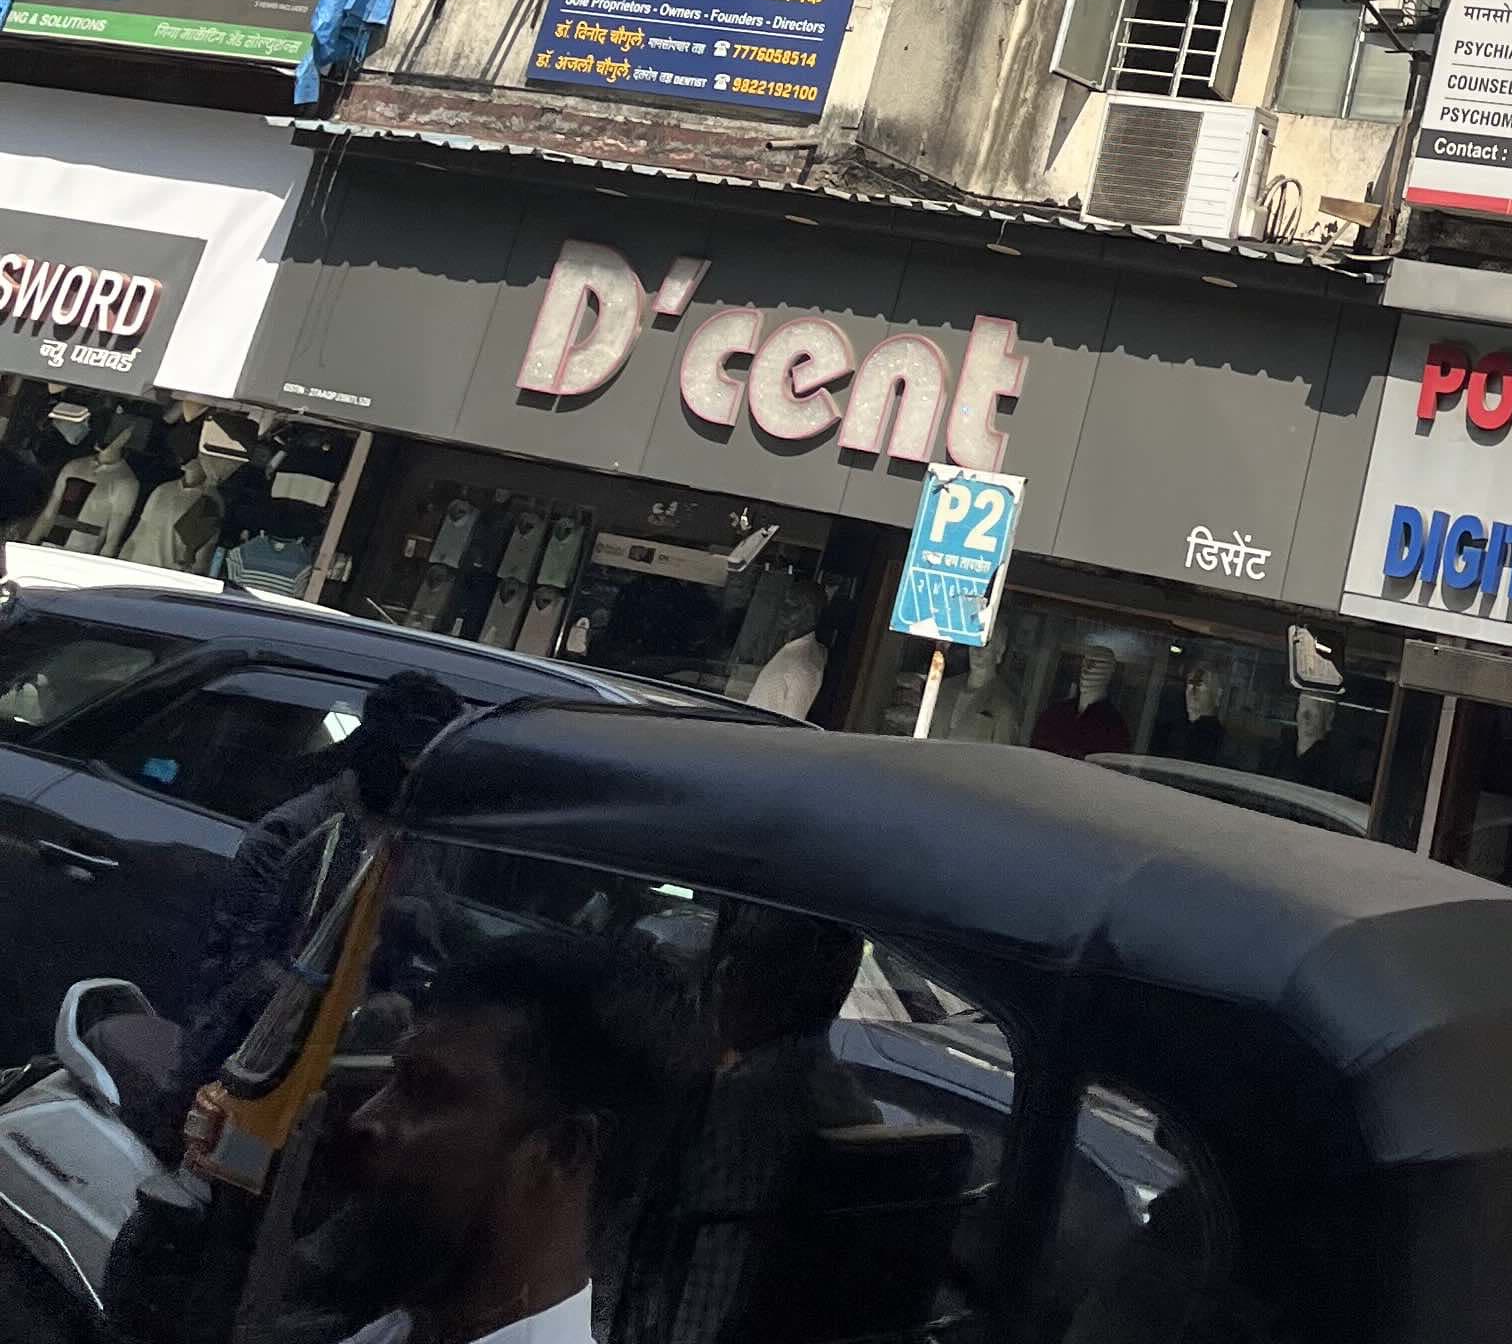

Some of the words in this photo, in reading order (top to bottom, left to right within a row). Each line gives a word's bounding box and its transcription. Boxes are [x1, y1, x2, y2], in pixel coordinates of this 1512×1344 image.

[40, 14, 107, 32] SOLUTIONS
[660, 3, 701, 20] Owners
[711, 9, 763, 27] Founders
[773, 16, 826, 34] Directors
[1434, 137, 1498, 160] Contact
[70, 343, 142, 372] पासवर्ड
[515, 239, 1029, 471] D'cent
[929, 483, 1006, 552] P2
[1185, 525, 1272, 580] डिसेंट
